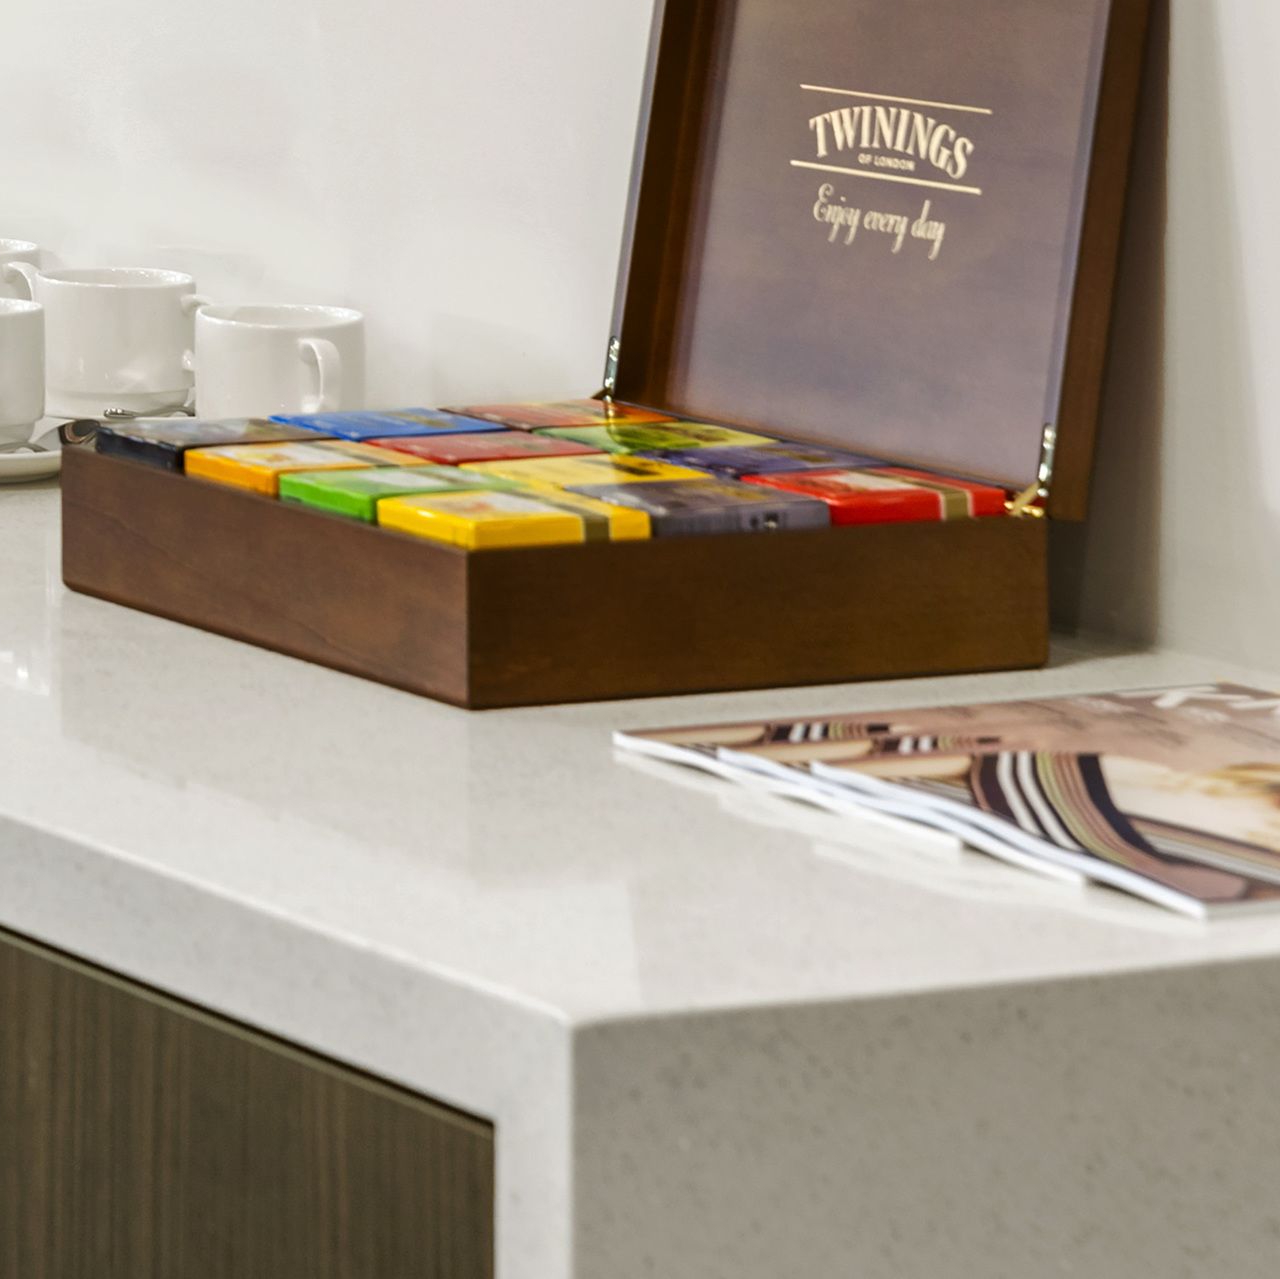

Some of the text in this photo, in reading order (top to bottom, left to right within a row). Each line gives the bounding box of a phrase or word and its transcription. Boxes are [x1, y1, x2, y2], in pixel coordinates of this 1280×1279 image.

[808, 106, 975, 180] TWININGS
[813, 183, 946, 261] Enjoy every day
